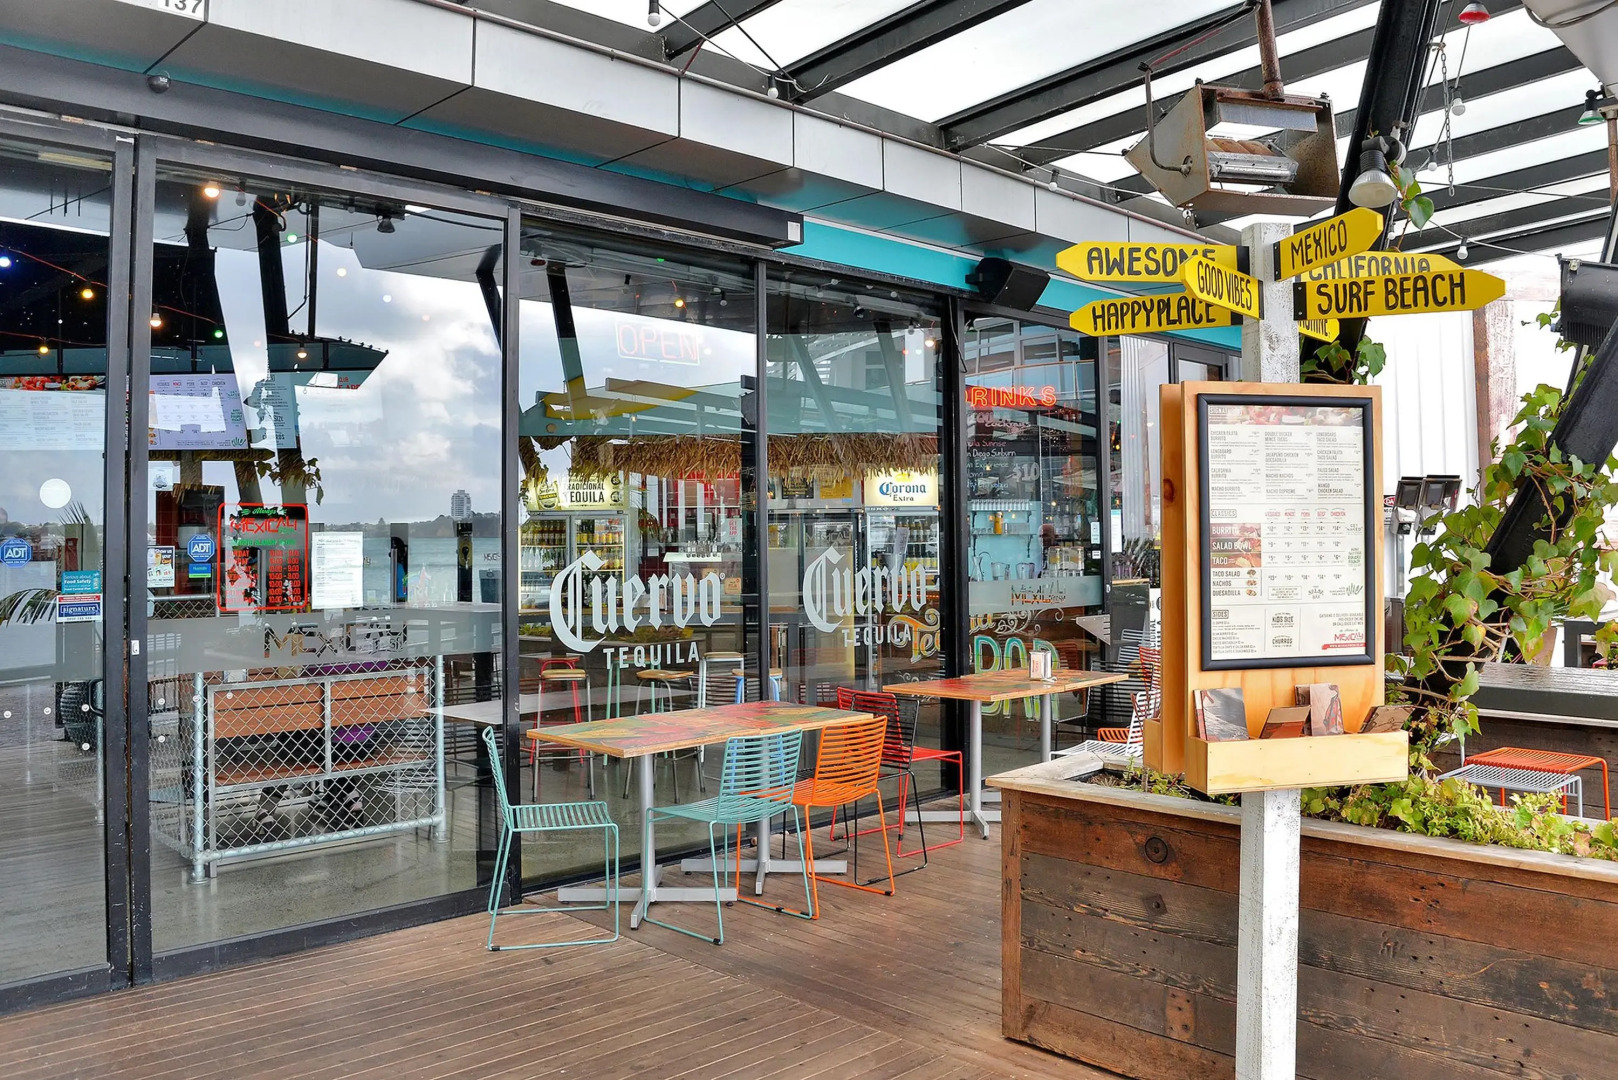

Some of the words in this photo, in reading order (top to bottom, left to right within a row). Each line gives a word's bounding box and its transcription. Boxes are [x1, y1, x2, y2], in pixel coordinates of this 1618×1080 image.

[1291, 219, 1348, 270] MEXICO
[1309, 255, 1431, 282] CALIFORNIA
[1197, 260, 1224, 302] GOOD
[1224, 272, 1253, 311] VIBES
[1317, 282, 1376, 315] SURF
[1384, 272, 1466, 311] BEACH
[618, 324, 698, 360] OPEN
[879, 481, 927, 498] Corona
[5, 547, 27, 559] ADT
[192, 543, 211, 553] ADT
[1212, 542, 1233, 550] SALAD
[1212, 557, 1228, 565] TACO
[549, 549, 722, 653] Cuervo
[802, 545, 927, 633] Cuervo
[1213, 589, 1241, 597] QUESADILLA
[63, 604, 96, 614] signature
[841, 623, 912, 648] TEQUILA
[603, 641, 700, 670] TEQUILA
